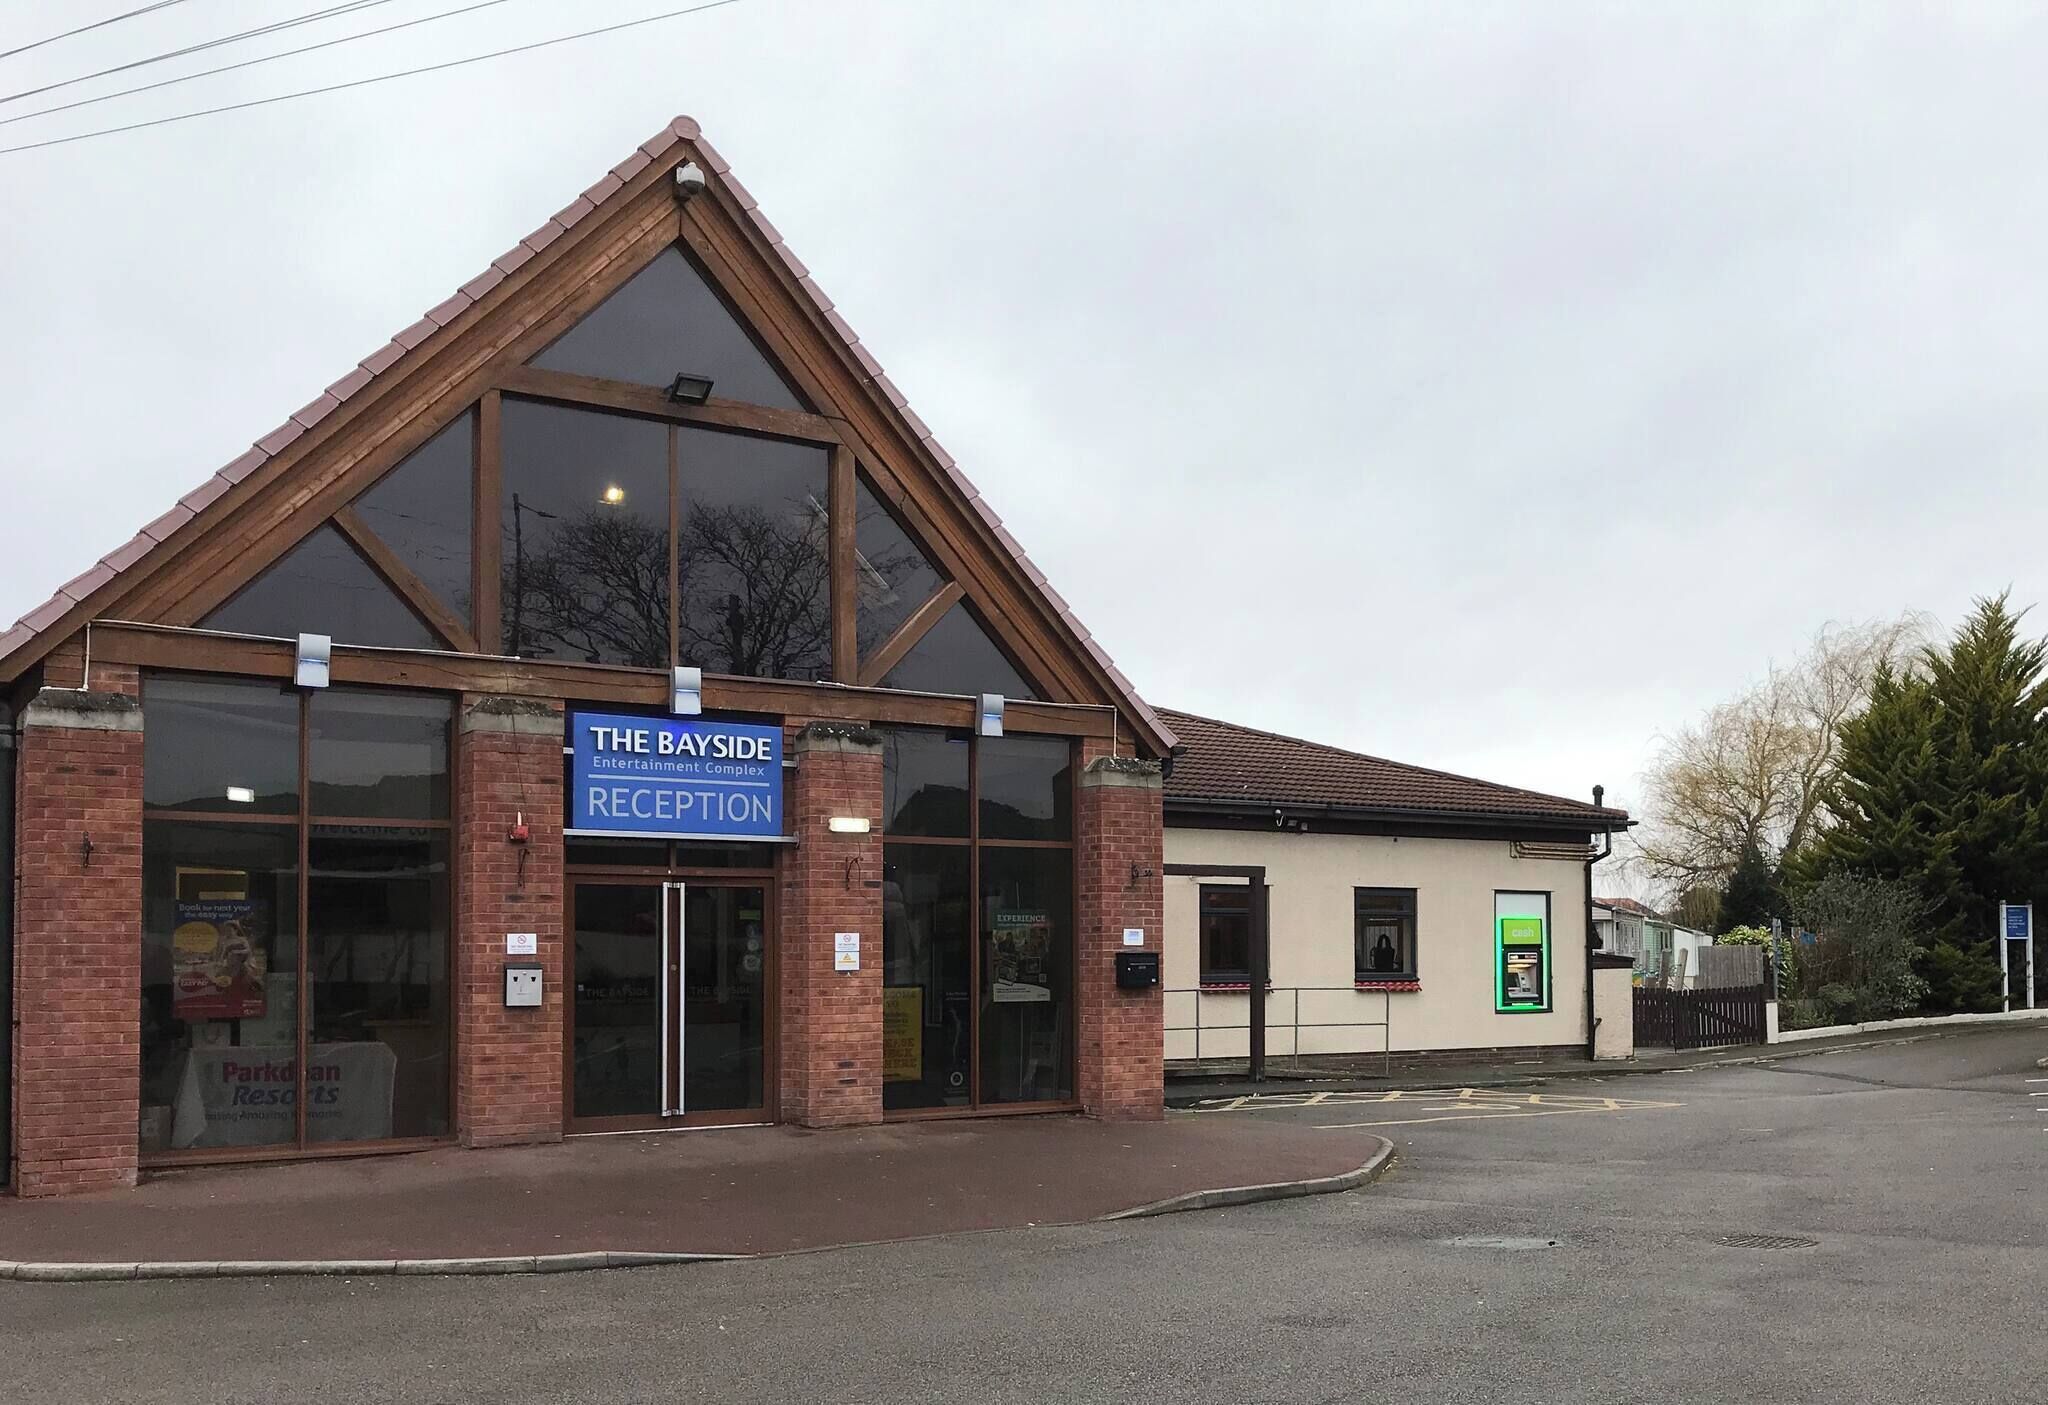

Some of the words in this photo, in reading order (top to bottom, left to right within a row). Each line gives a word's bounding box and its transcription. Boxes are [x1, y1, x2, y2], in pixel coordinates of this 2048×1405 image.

[590, 726, 651, 754] THE
[658, 731, 772, 761] BAYSIDE
[593, 756, 700, 773] Entertainment
[705, 762, 765, 777] Complex
[588, 787, 772, 823] RECEPTION
[997, 914, 1046, 923] EXPERIENCE
[1512, 927, 1535, 937] cash
[223, 1062, 341, 1084] Parkdan
[232, 1085, 340, 1106] Resots
